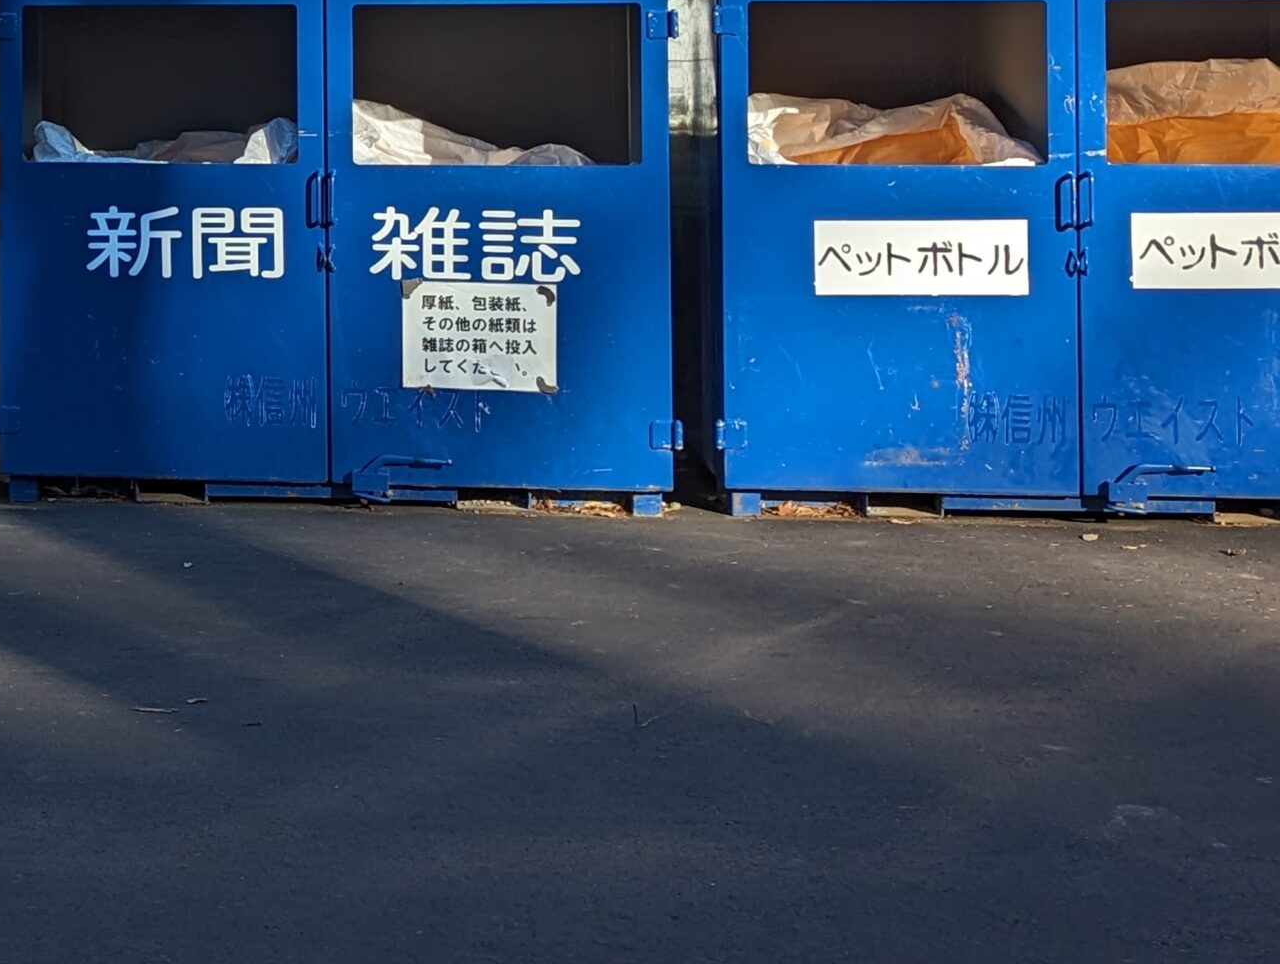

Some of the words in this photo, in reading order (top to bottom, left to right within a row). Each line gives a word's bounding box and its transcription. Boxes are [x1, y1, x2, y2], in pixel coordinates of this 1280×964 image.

[86, 204, 286, 280] 新聞
[369, 205, 582, 283] 雑誌
[817, 240, 1025, 277] ペットボトル
[1138, 232, 1280, 271] ペットボ
[421, 316, 538, 334] その他の紙類は
[421, 336, 538, 356] 雑誌の箱へ投入
